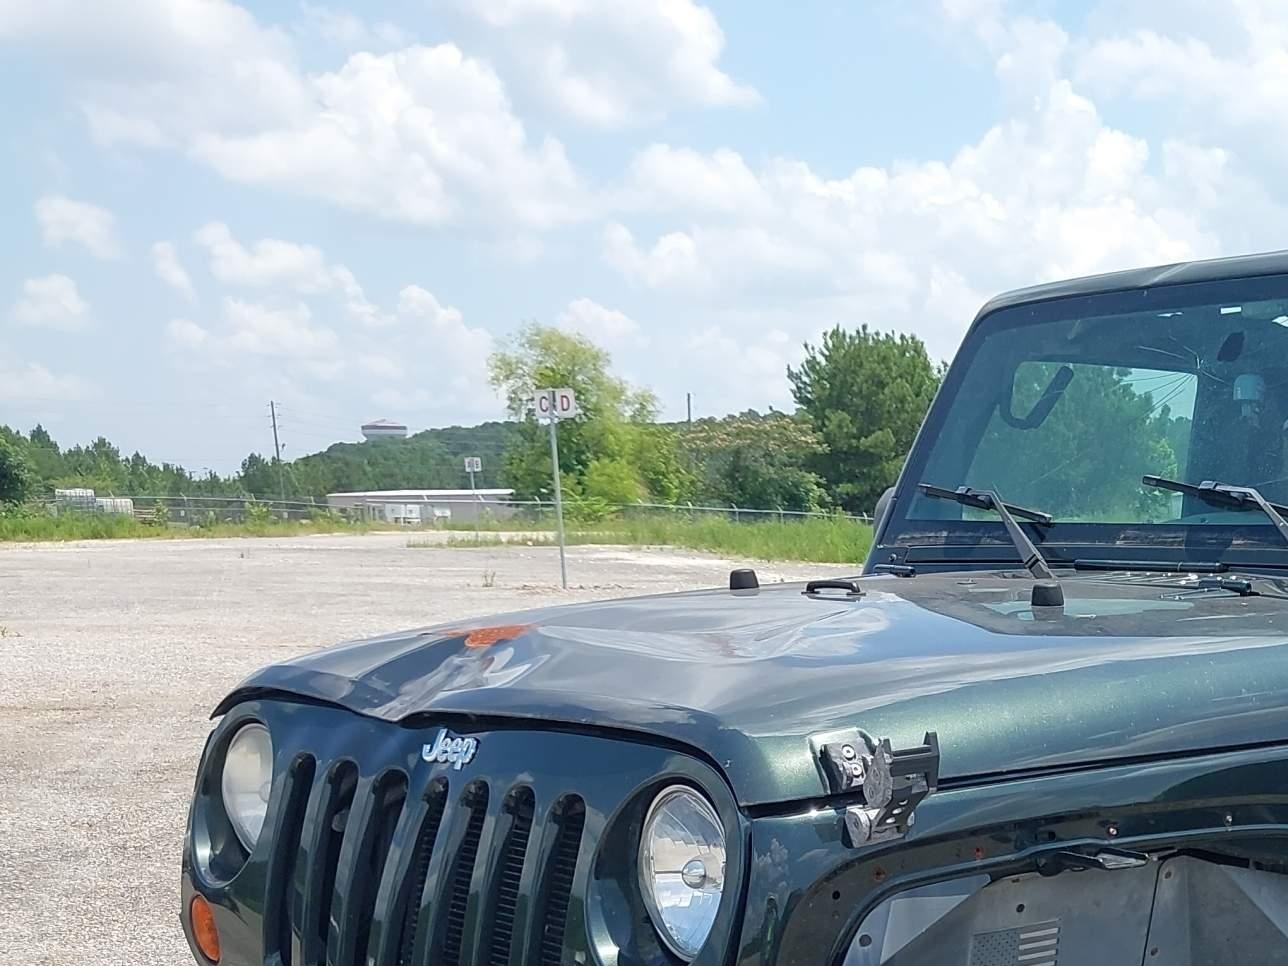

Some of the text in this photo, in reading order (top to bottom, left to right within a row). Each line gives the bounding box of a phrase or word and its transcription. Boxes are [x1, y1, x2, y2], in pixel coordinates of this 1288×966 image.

[540, 396, 549, 412] C
[560, 395, 571, 411] D
[422, 728, 478, 770] Jeep
